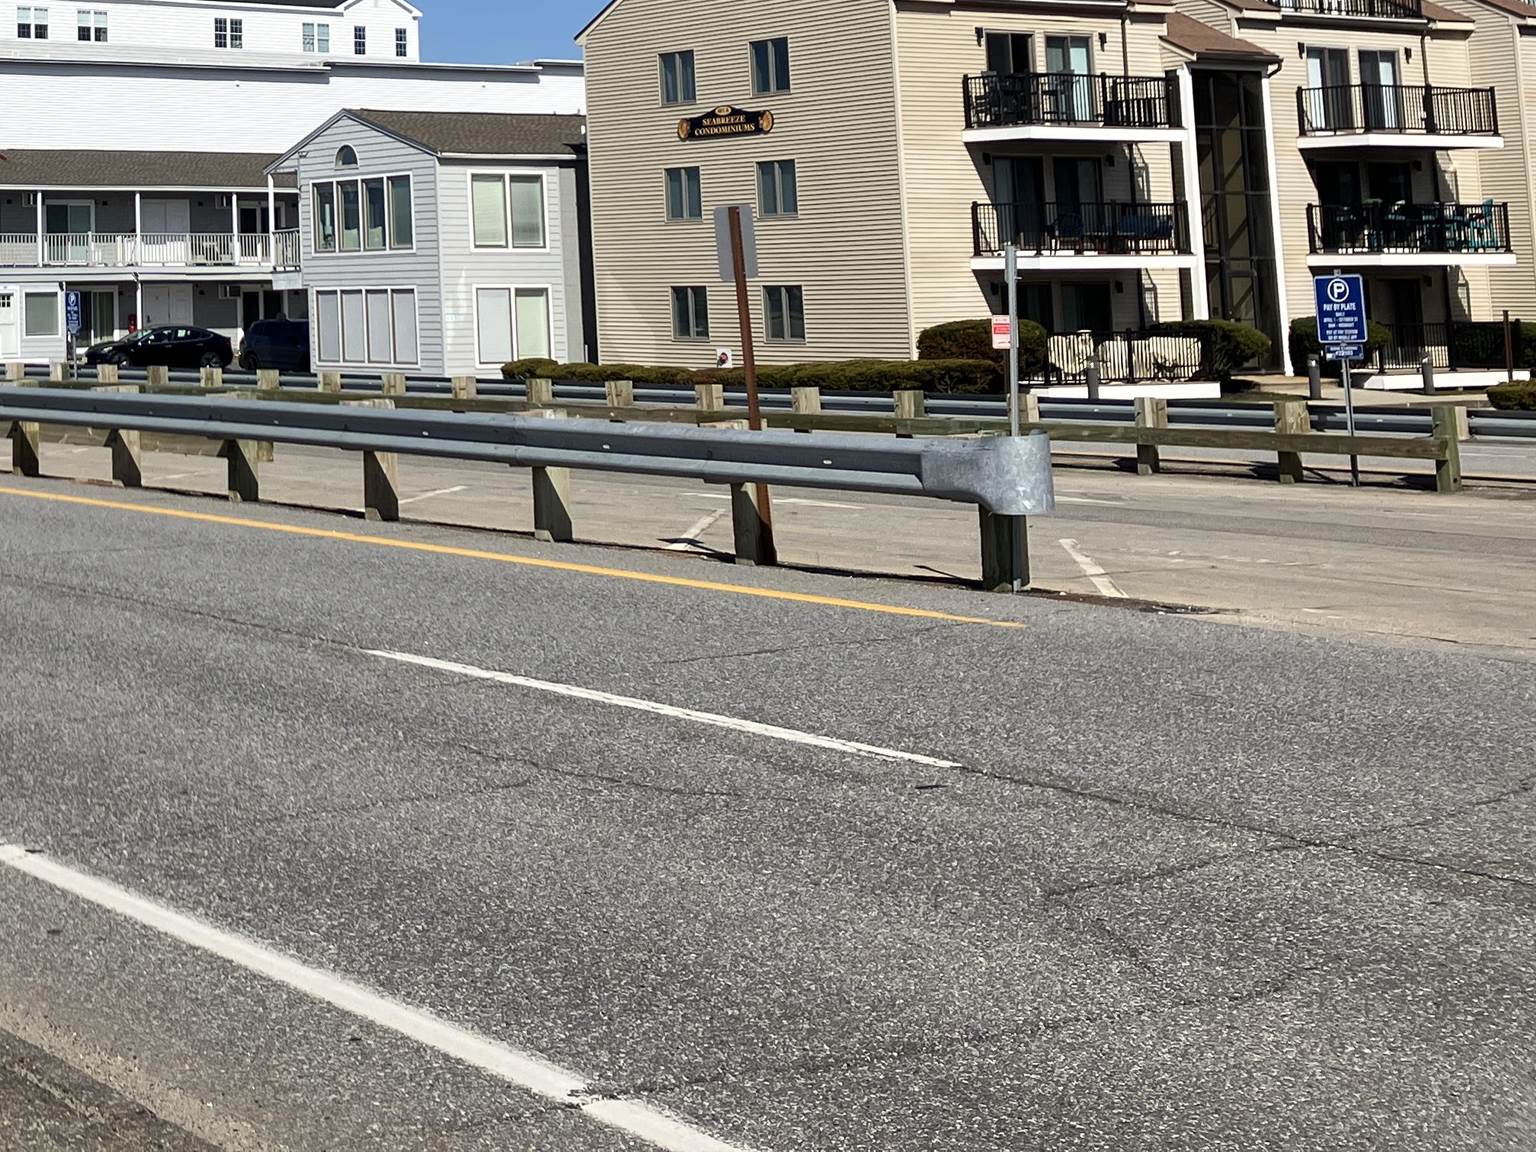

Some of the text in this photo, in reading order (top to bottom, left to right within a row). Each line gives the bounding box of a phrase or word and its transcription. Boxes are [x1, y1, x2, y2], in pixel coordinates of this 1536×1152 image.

[702, 115, 746, 125] SEABREEZE
[694, 123, 756, 136] CONDOMINIUMS
[1341, 302, 1357, 311] PLATE
